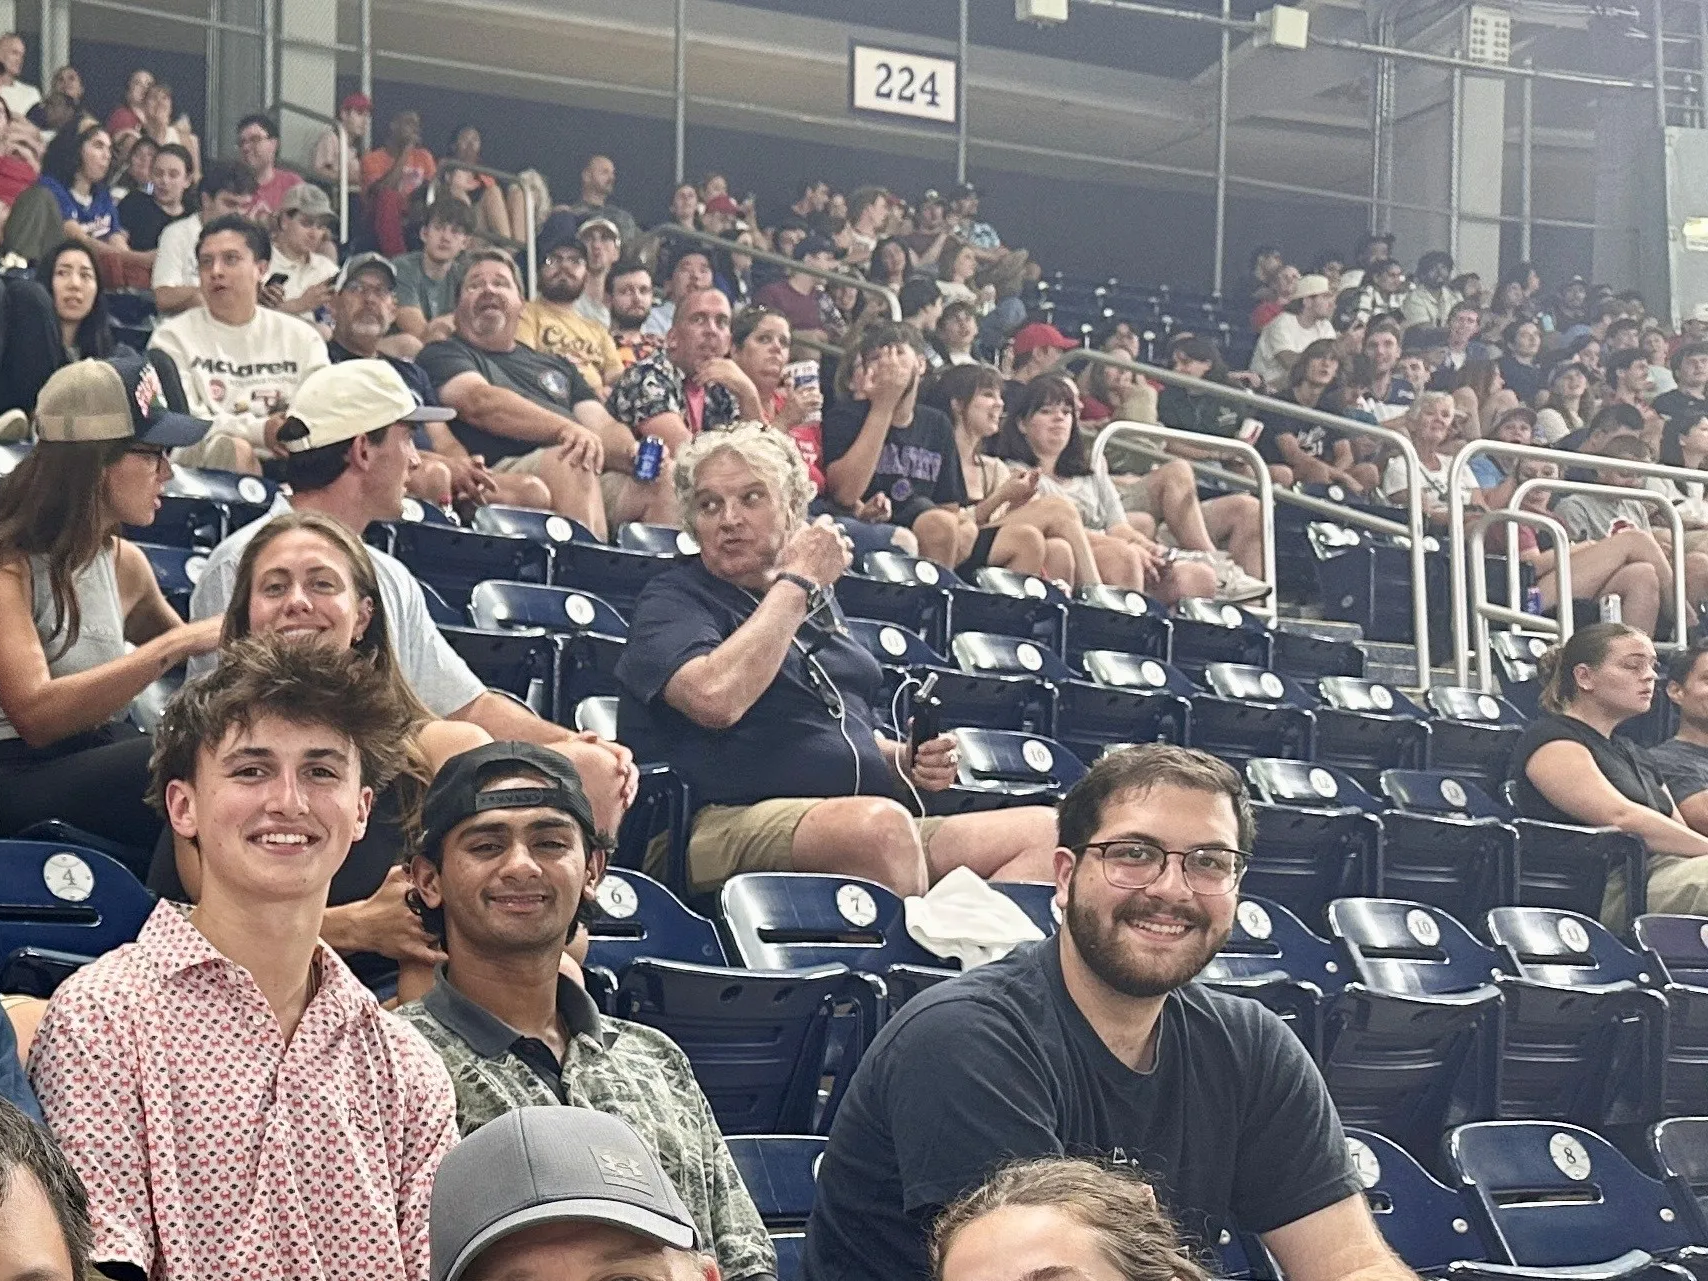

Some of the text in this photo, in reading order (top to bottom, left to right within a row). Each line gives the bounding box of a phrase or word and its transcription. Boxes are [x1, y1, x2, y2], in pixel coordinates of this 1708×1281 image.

[876, 62, 939, 107] 224
[192, 356, 298, 377] McLaren
[62, 868, 78, 886] 4
[610, 887, 622, 905] 6
[849, 896, 860, 913] 7
[1248, 910, 1259, 928] 9
[1414, 920, 1432, 935] 10
[1350, 1152, 1362, 1170] 7
[1563, 1147, 1577, 1165] 8
